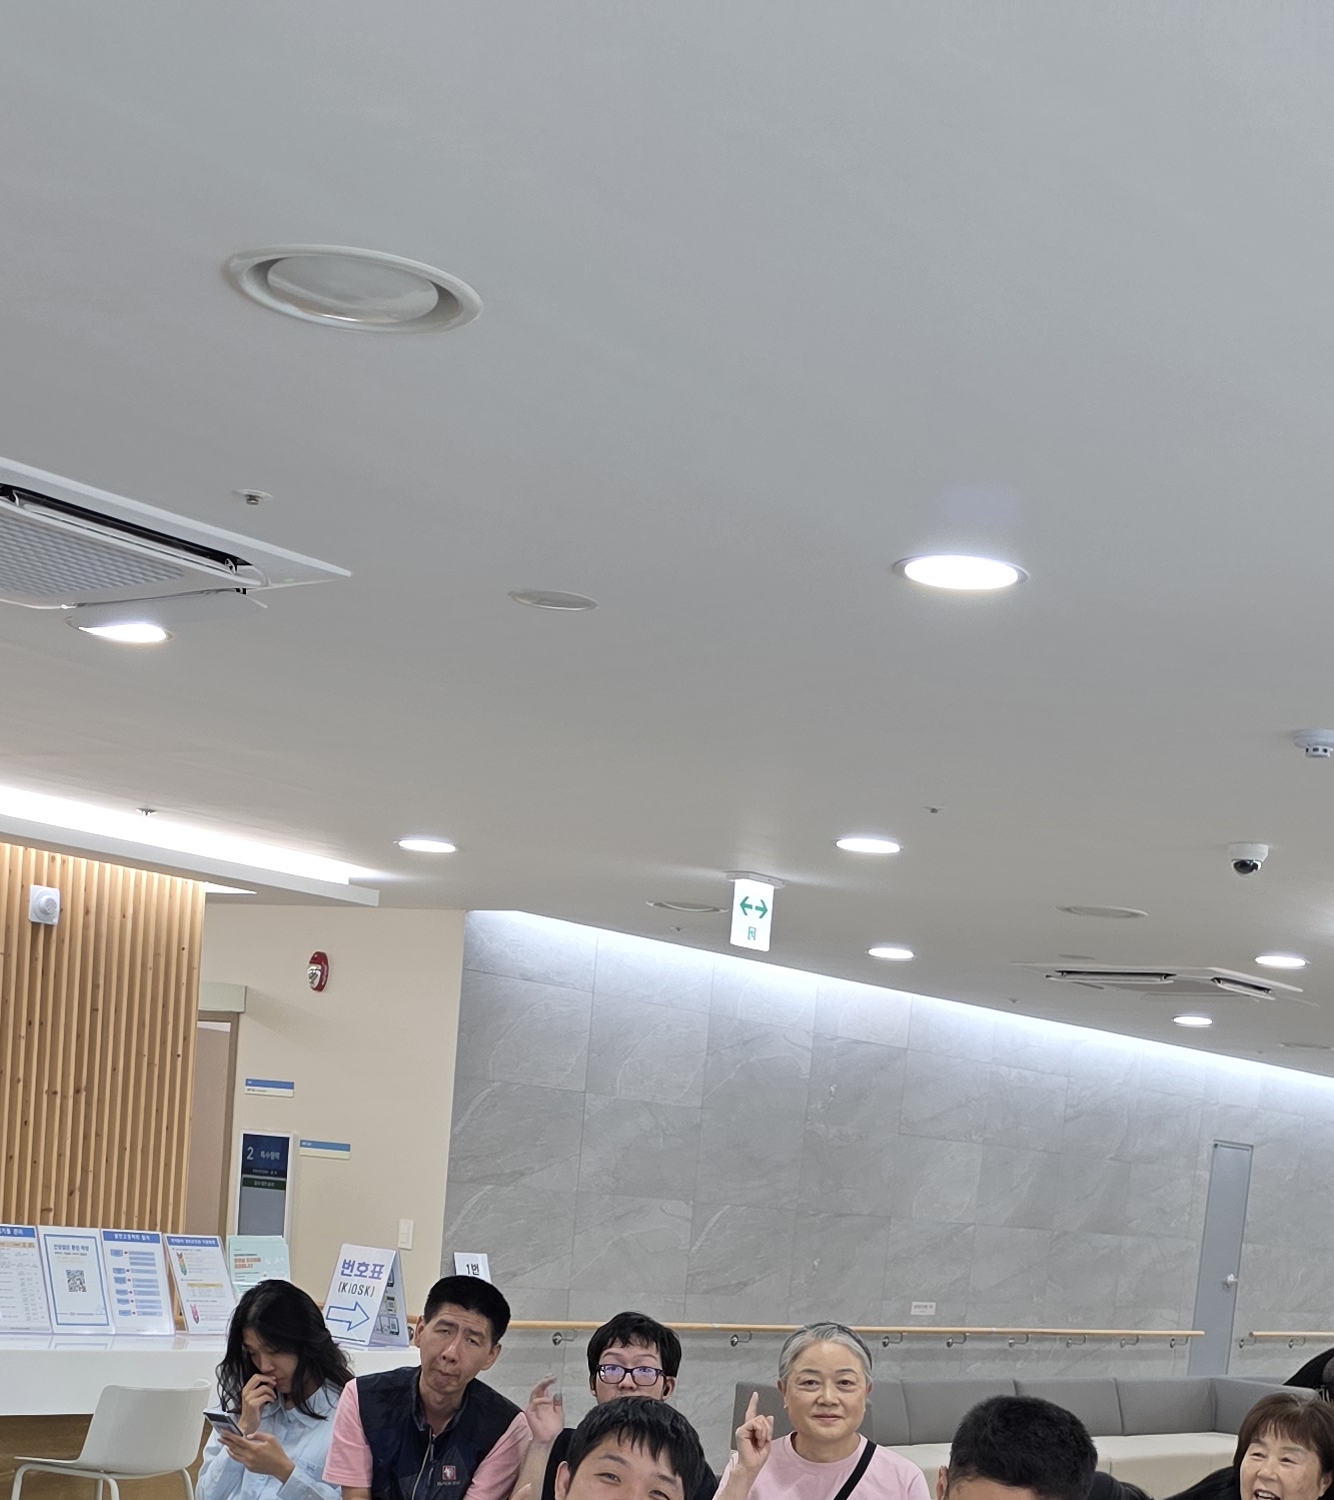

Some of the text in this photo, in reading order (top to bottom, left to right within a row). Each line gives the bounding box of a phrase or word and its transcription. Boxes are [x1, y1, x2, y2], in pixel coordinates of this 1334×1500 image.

[246, 1146, 254, 1160] 2
[340, 1259, 385, 1281] 번호표
[466, 1263, 480, 1276] 1번
